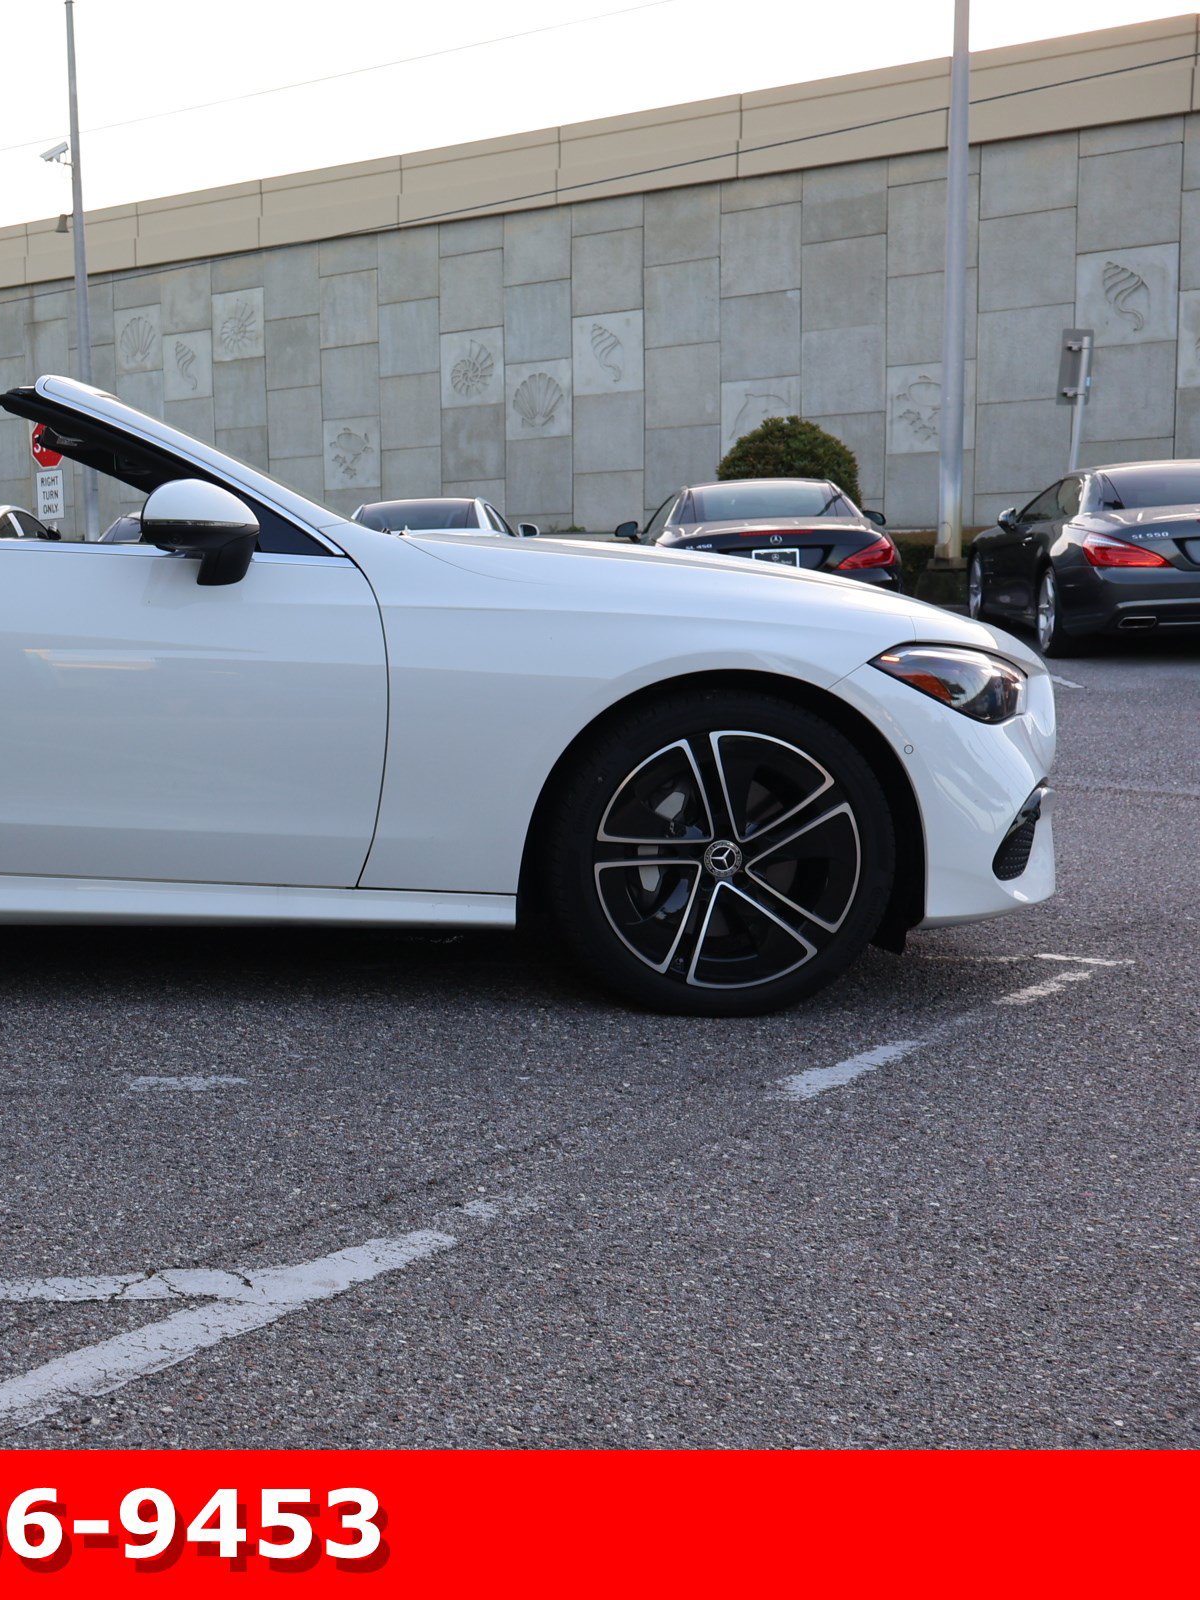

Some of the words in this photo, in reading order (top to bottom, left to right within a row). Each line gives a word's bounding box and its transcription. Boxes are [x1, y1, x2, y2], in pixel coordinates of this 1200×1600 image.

[40, 475, 59, 487] RIGHT
[42, 490, 59, 501] TURN
[43, 503, 59, 514] ONLY
